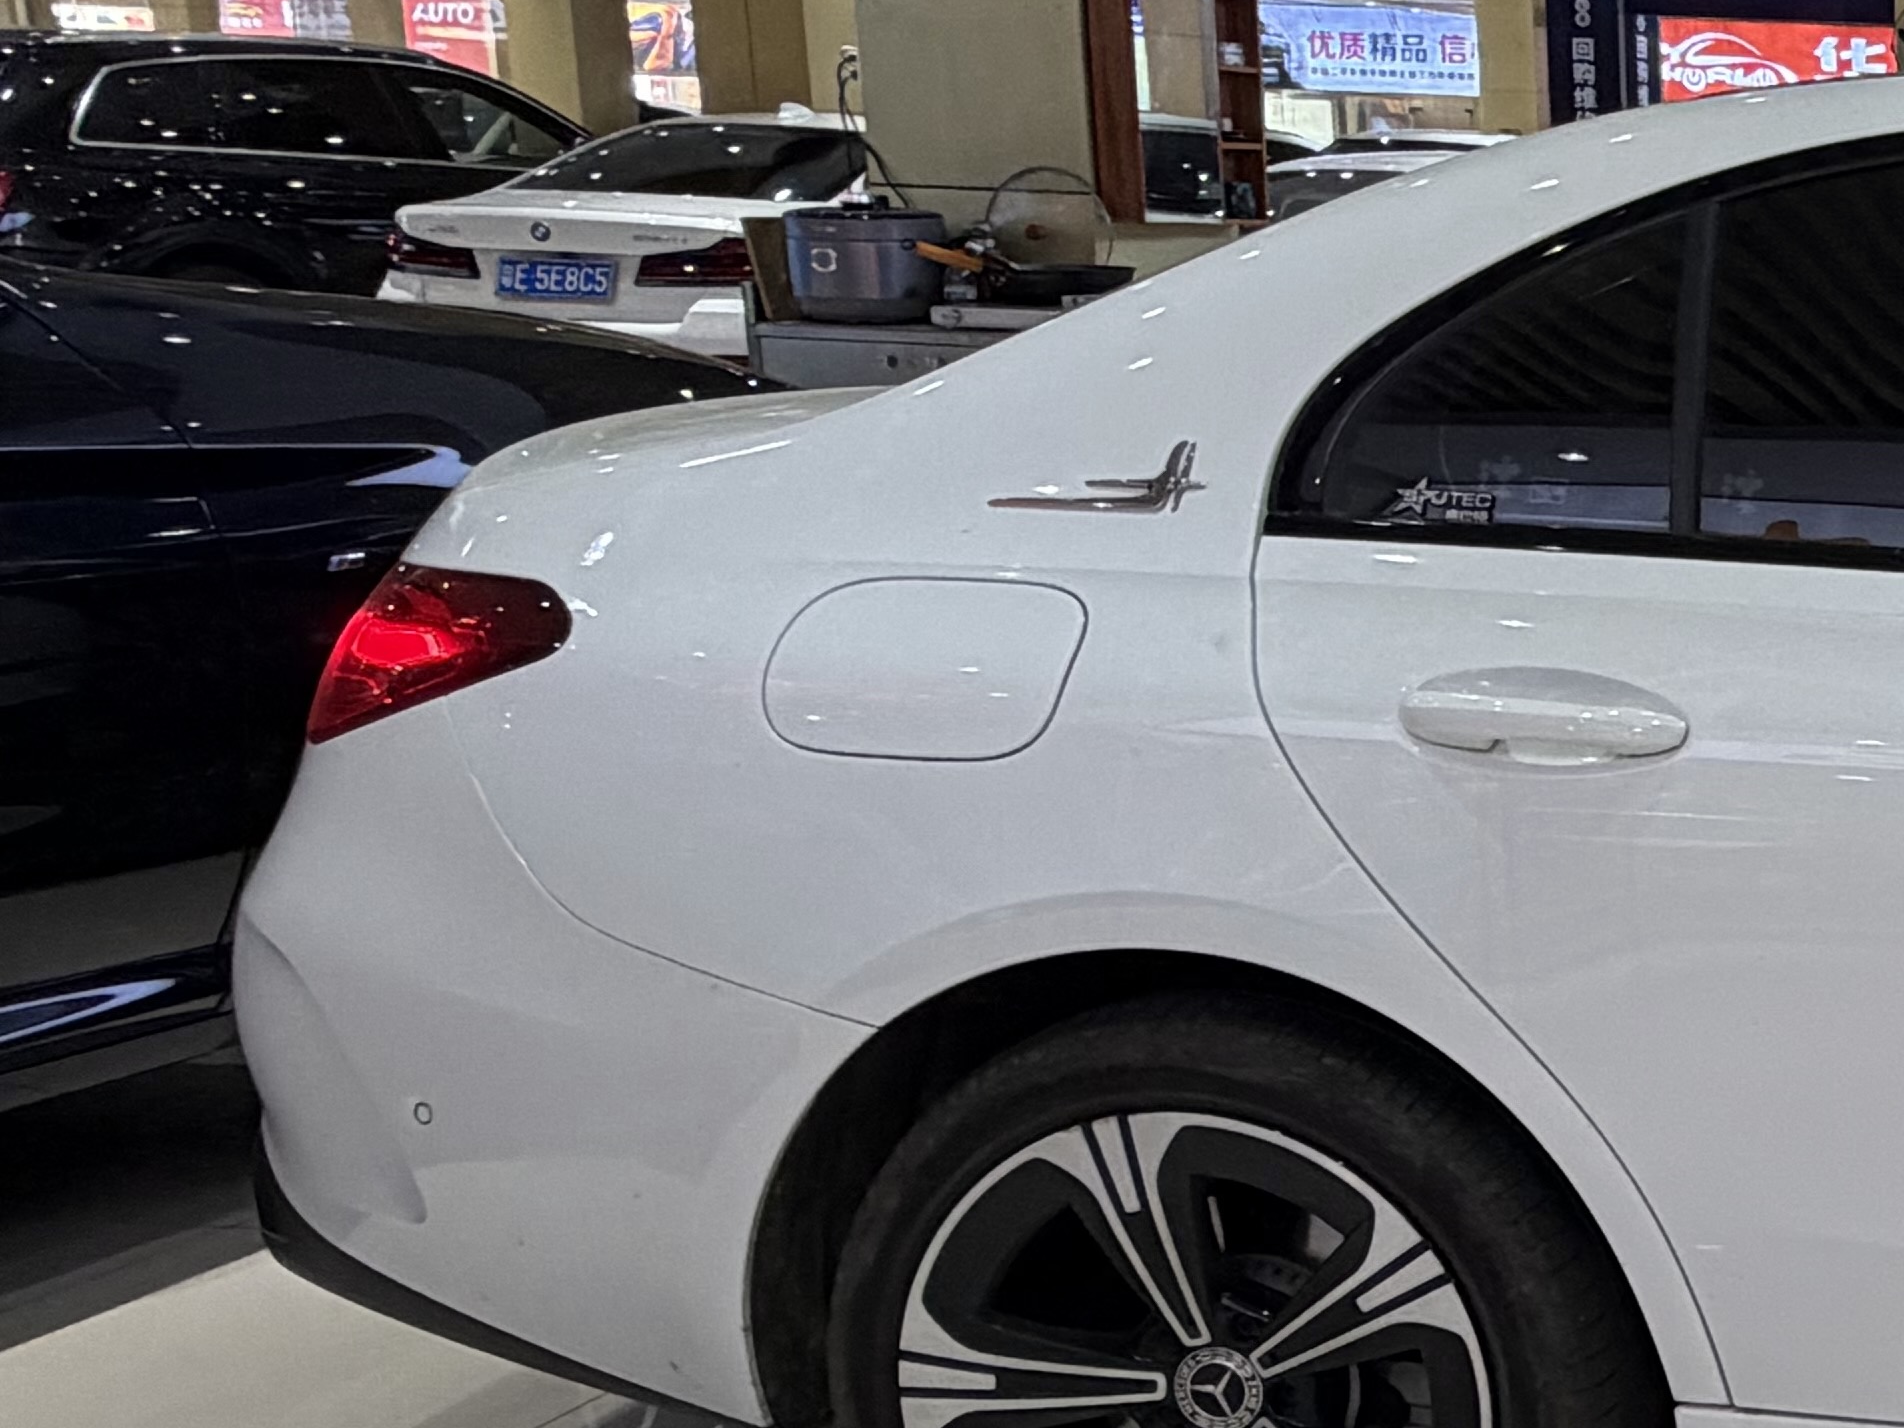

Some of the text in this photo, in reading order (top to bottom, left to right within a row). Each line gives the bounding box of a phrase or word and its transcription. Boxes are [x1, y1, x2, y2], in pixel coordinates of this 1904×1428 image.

[412, 2, 475, 24] AUTO
[1307, 30, 1475, 64] 优质精品 信
[534, 265, 609, 294] 5E8C5
